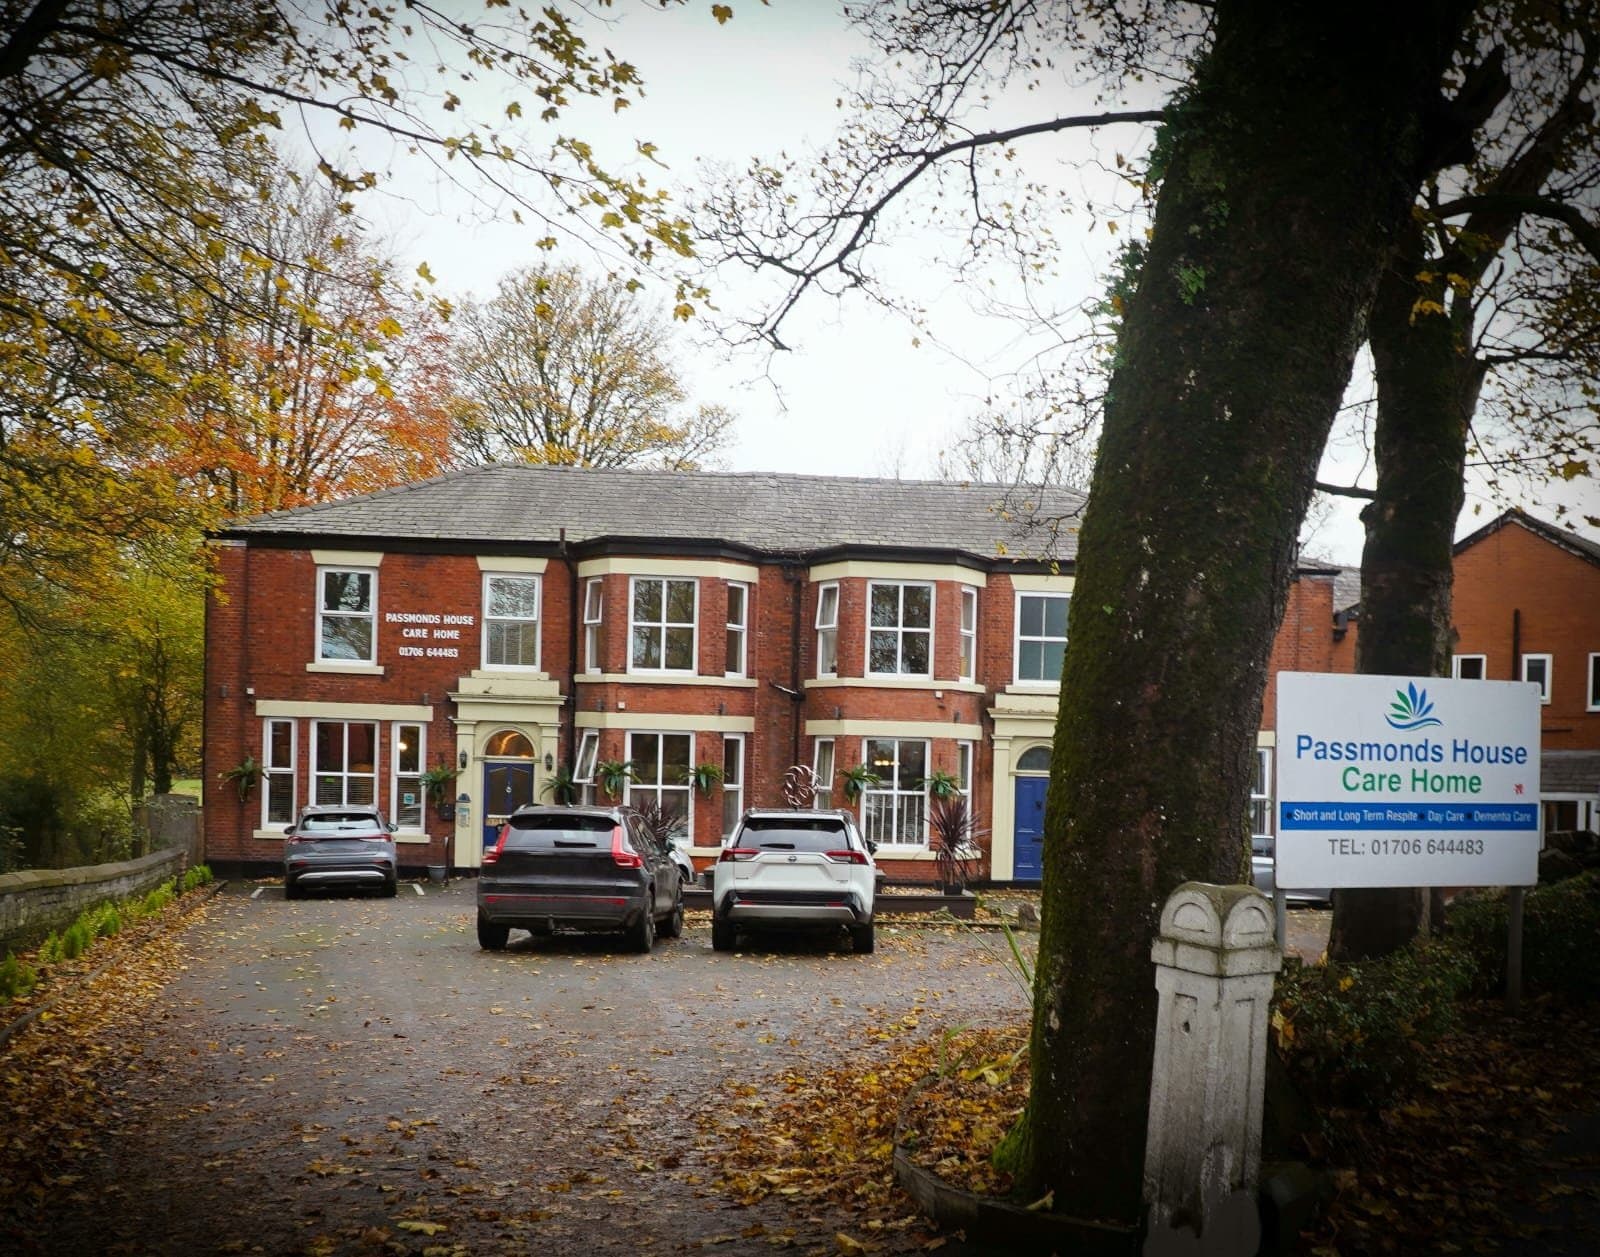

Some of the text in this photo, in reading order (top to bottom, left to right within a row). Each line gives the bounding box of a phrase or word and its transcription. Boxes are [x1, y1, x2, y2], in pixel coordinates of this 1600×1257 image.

[386, 613, 474, 625] PASSMONDS HOUSE
[402, 628, 460, 639] CARE HOME
[399, 647, 458, 657] 01706 644483
[1296, 734, 1527, 765] Passmonds House
[1342, 766, 1482, 793] Care Home
[1293, 808, 1531, 824] Short and Long Term Respite Day Care Dementia Care
[1328, 838, 1484, 855] TEL: 01706 644483
